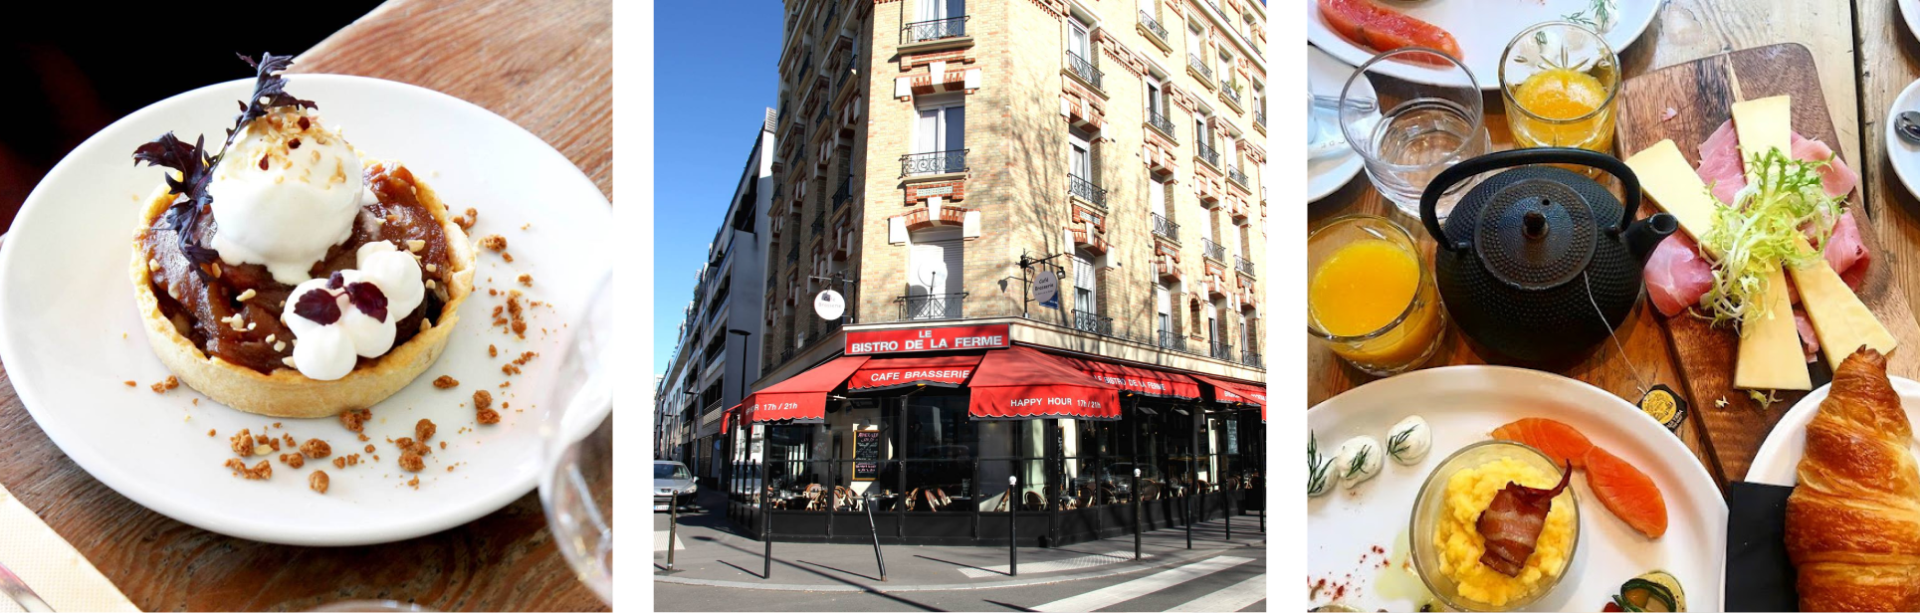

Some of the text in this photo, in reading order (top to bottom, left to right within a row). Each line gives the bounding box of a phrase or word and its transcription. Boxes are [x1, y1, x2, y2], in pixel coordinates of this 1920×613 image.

[919, 330, 932, 338] LE
[851, 335, 1003, 353] BISTRO DE LA FERME
[870, 370, 970, 382] CAFE BRASSERIE
[1104, 376, 1126, 386] BISTRO
[1128, 379, 1139, 387] DE
[1139, 380, 1147, 388] LA
[1147, 381, 1166, 391] FERME
[763, 403, 777, 411] 17h
[783, 402, 798, 410] 21h
[1010, 398, 1042, 407] HAPPY
[1047, 397, 1072, 406] HOUR
